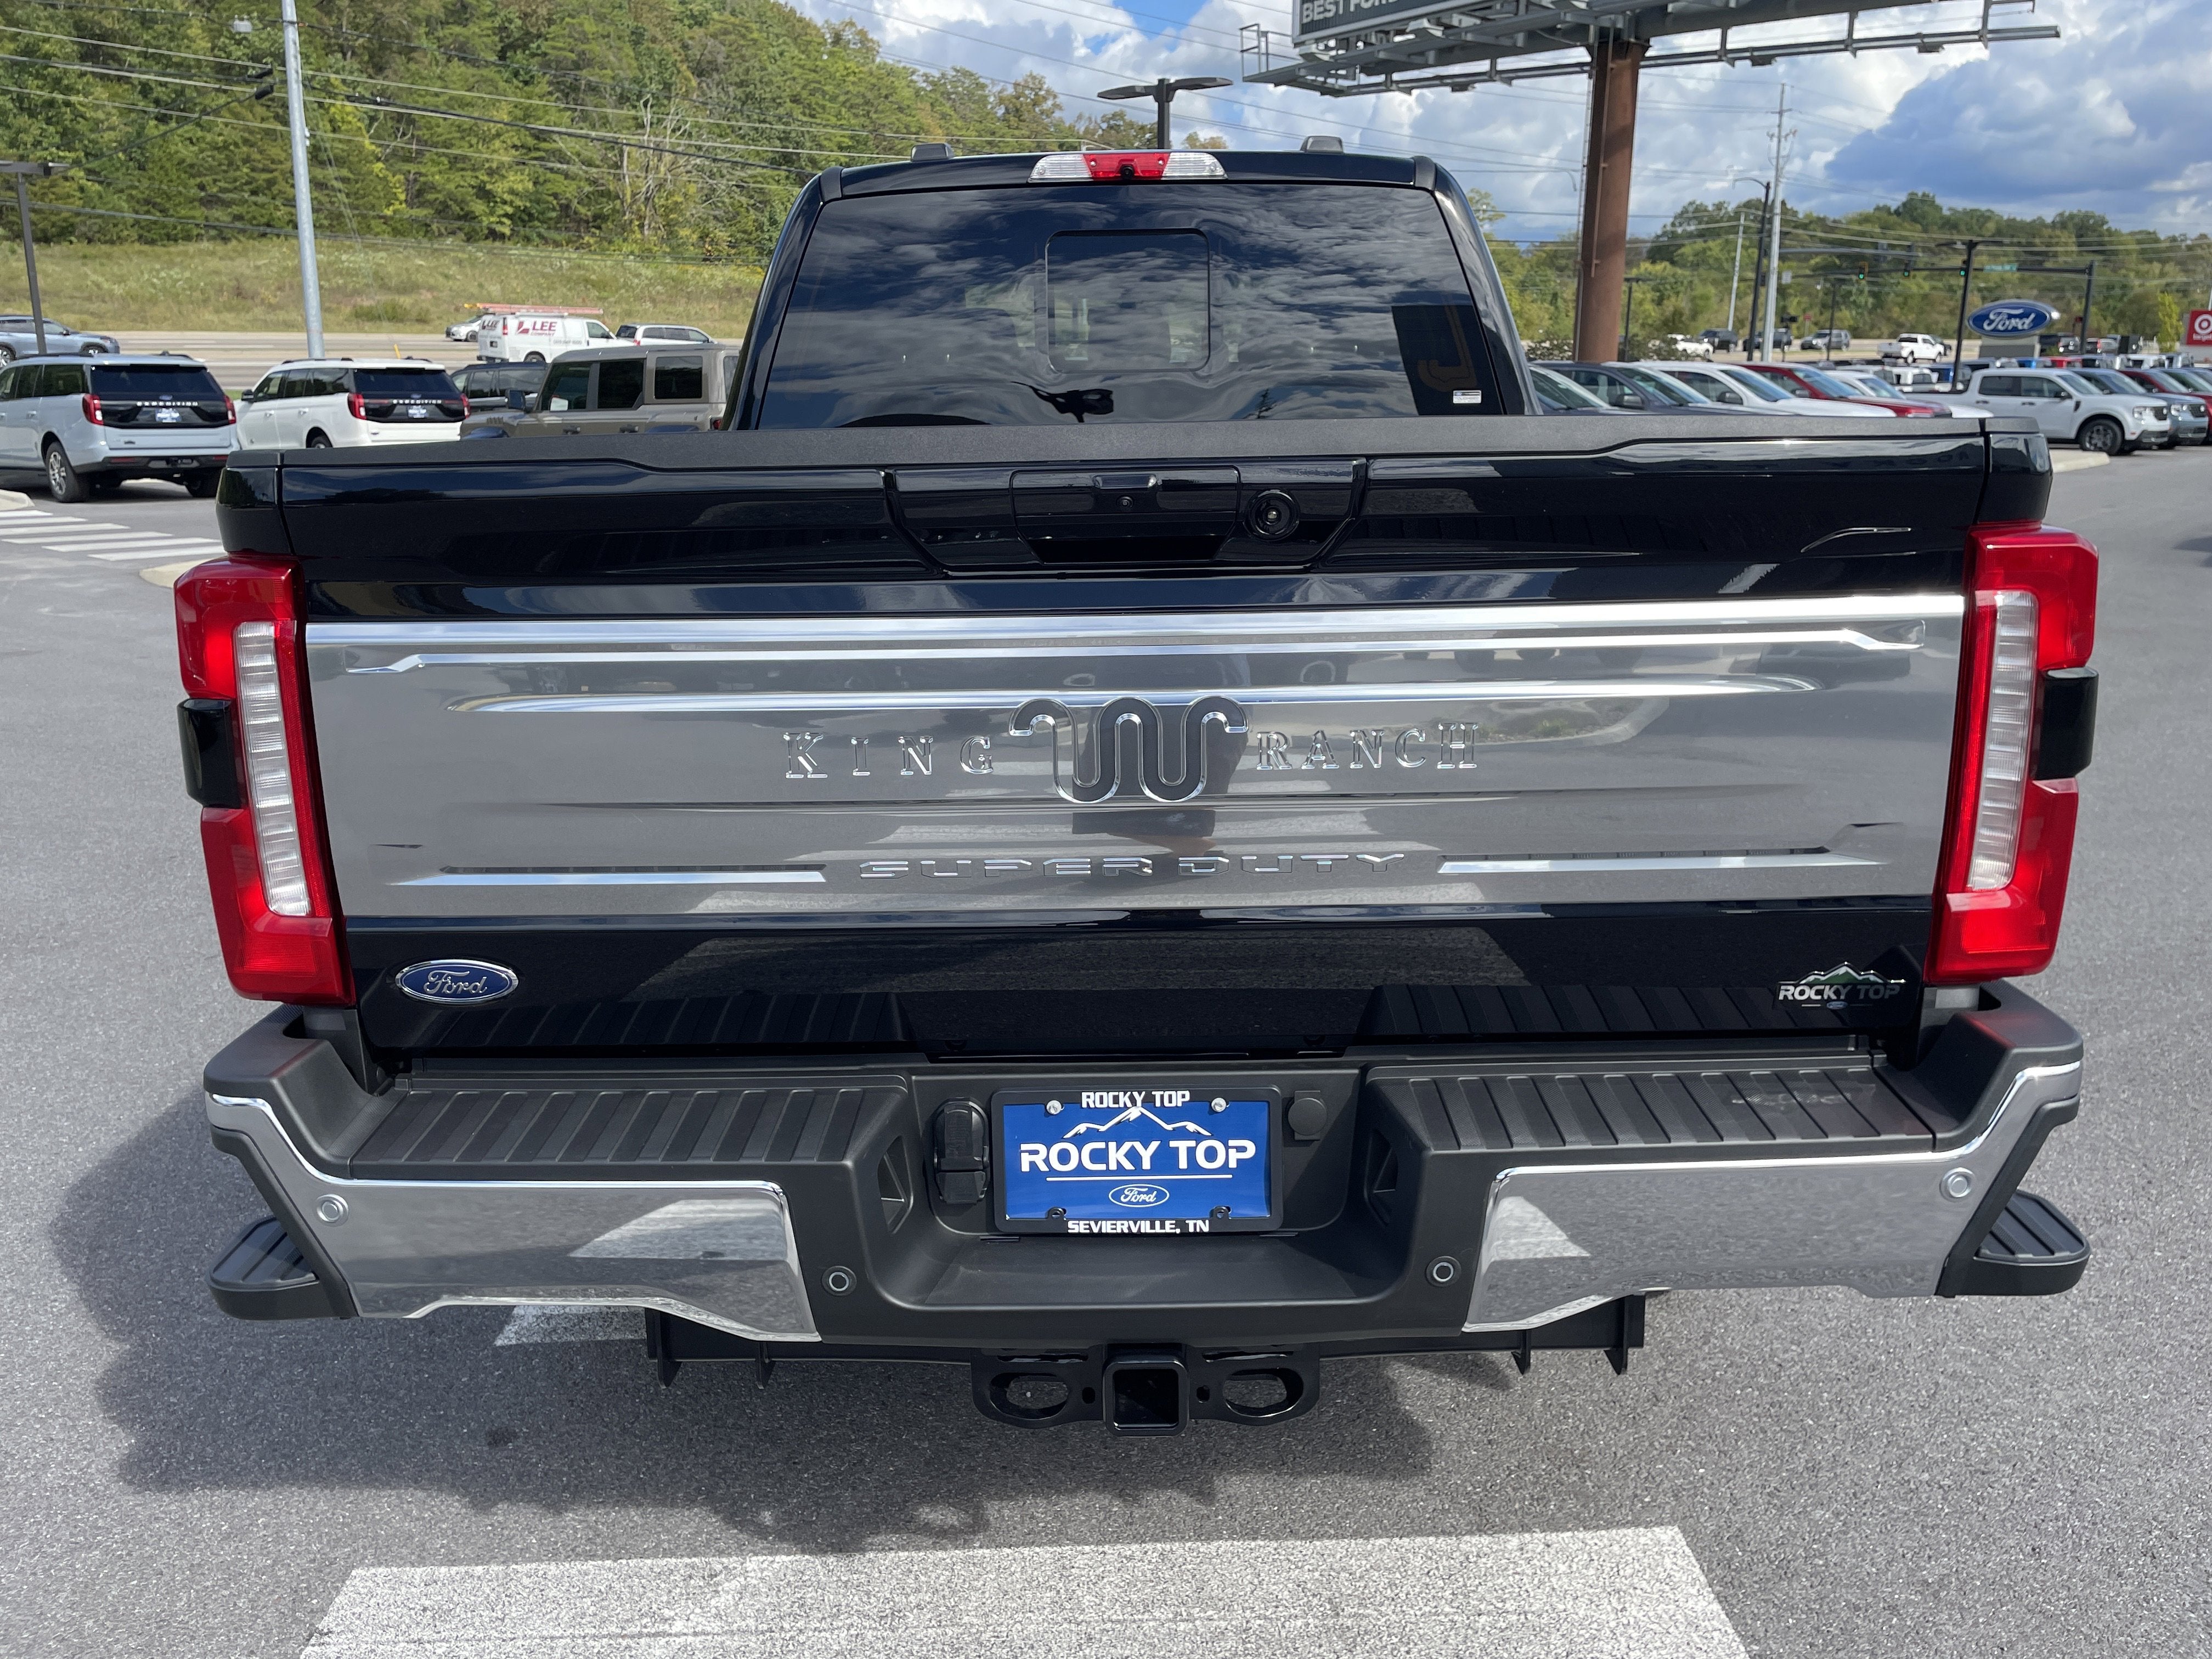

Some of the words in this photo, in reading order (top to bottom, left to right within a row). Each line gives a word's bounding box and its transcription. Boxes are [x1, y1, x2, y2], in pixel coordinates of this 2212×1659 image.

[532, 321, 557, 331] LEE
[1983, 308, 2036, 331] Ford
[783, 731, 994, 779] KING
[1256, 722, 1479, 770] RANCH
[860, 857, 1153, 879] SUPER
[1178, 853, 1404, 876] DUTY
[424, 969, 487, 994] Ford
[1778, 985, 1853, 1000] ROCKY
[1857, 985, 1900, 1000] TOP
[1081, 1091, 1146, 1108] ROCKY
[1152, 1091, 1190, 1107] TOP
[1019, 1140, 1161, 1172] ROCKY
[1169, 1139, 1256, 1170] TOP
[1120, 1187, 1157, 1203] Ford
[1067, 1220, 1181, 1234] SEVIERVILLE,
[1186, 1220, 1209, 1233] TN
